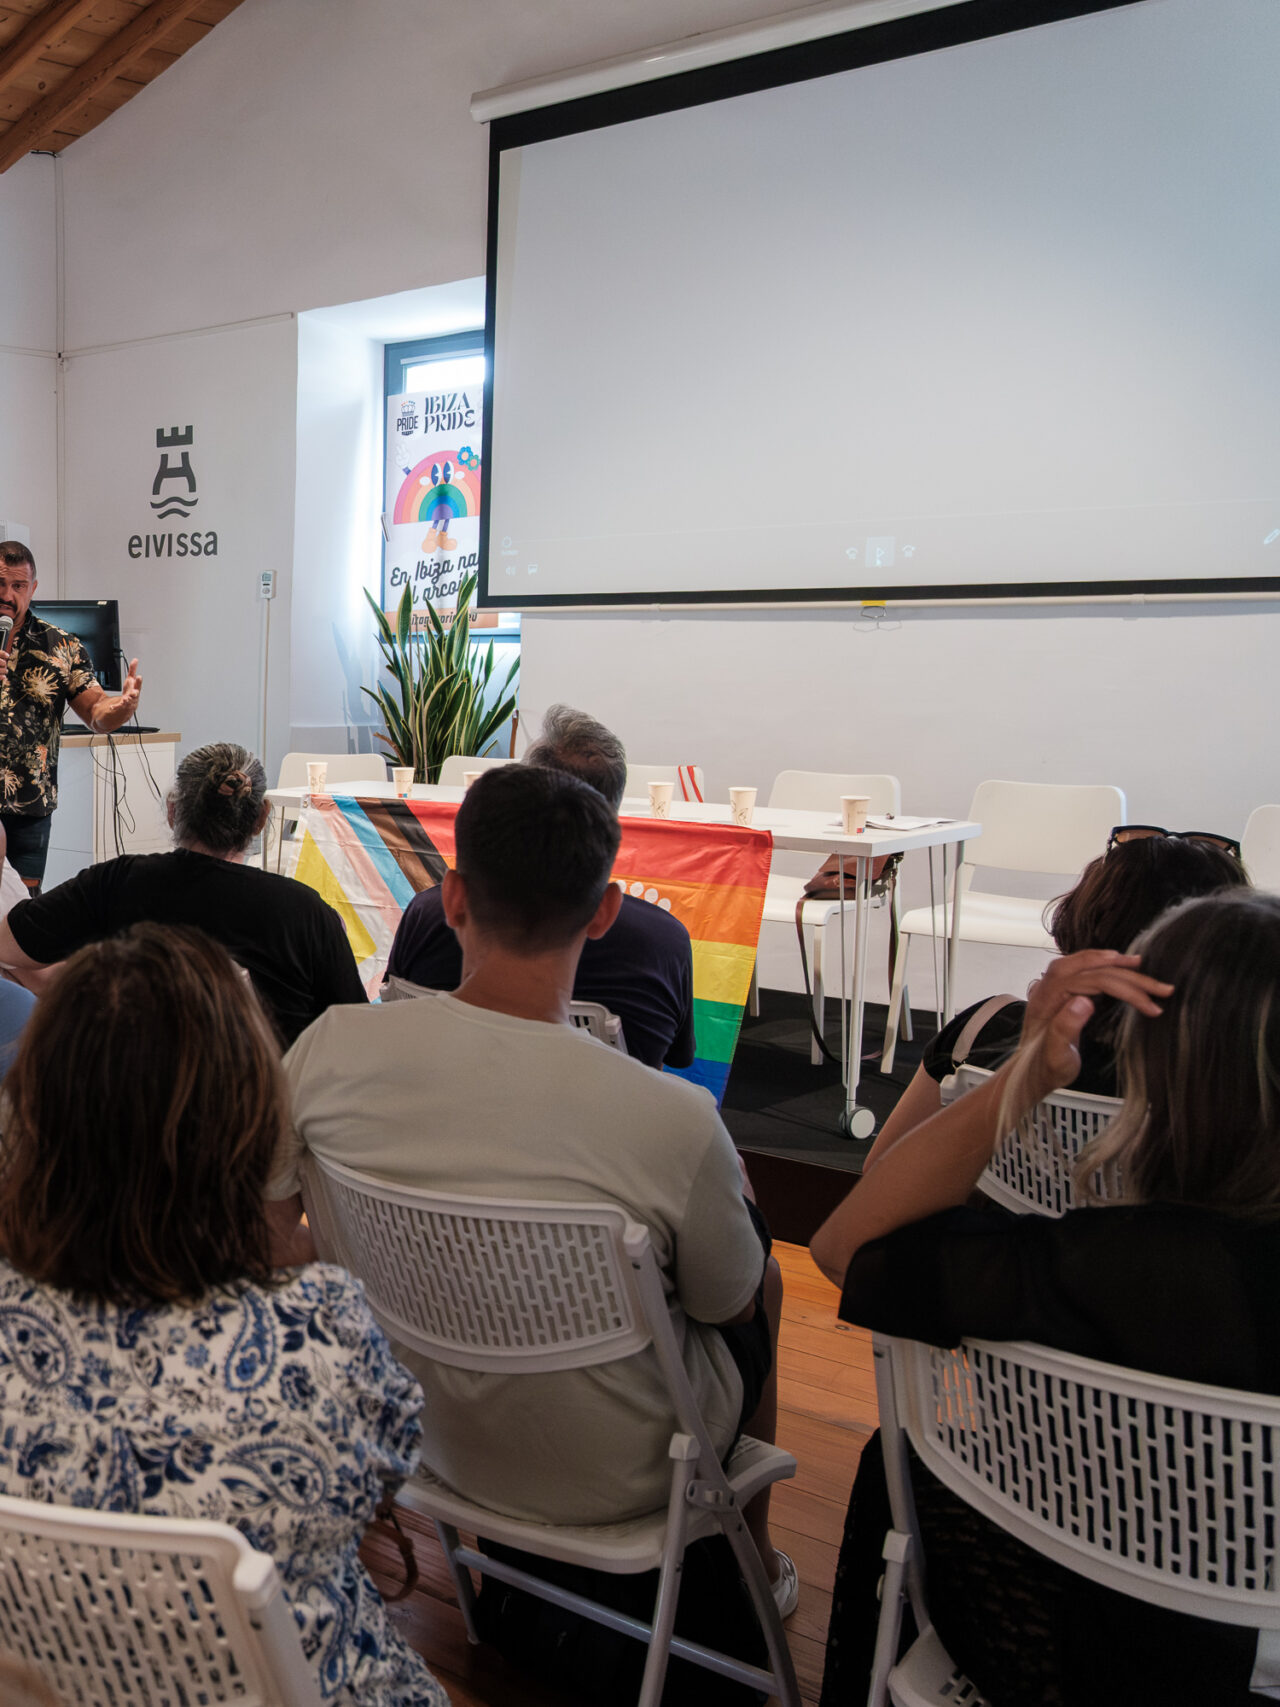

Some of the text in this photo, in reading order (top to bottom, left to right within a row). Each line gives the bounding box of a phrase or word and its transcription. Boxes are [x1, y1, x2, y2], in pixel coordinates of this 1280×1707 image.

[424, 392, 470, 415] IBIZA
[396, 415, 419, 432] PRIDE
[424, 409, 475, 434] PRIDE
[390, 552, 479, 587] En Ibiza na
